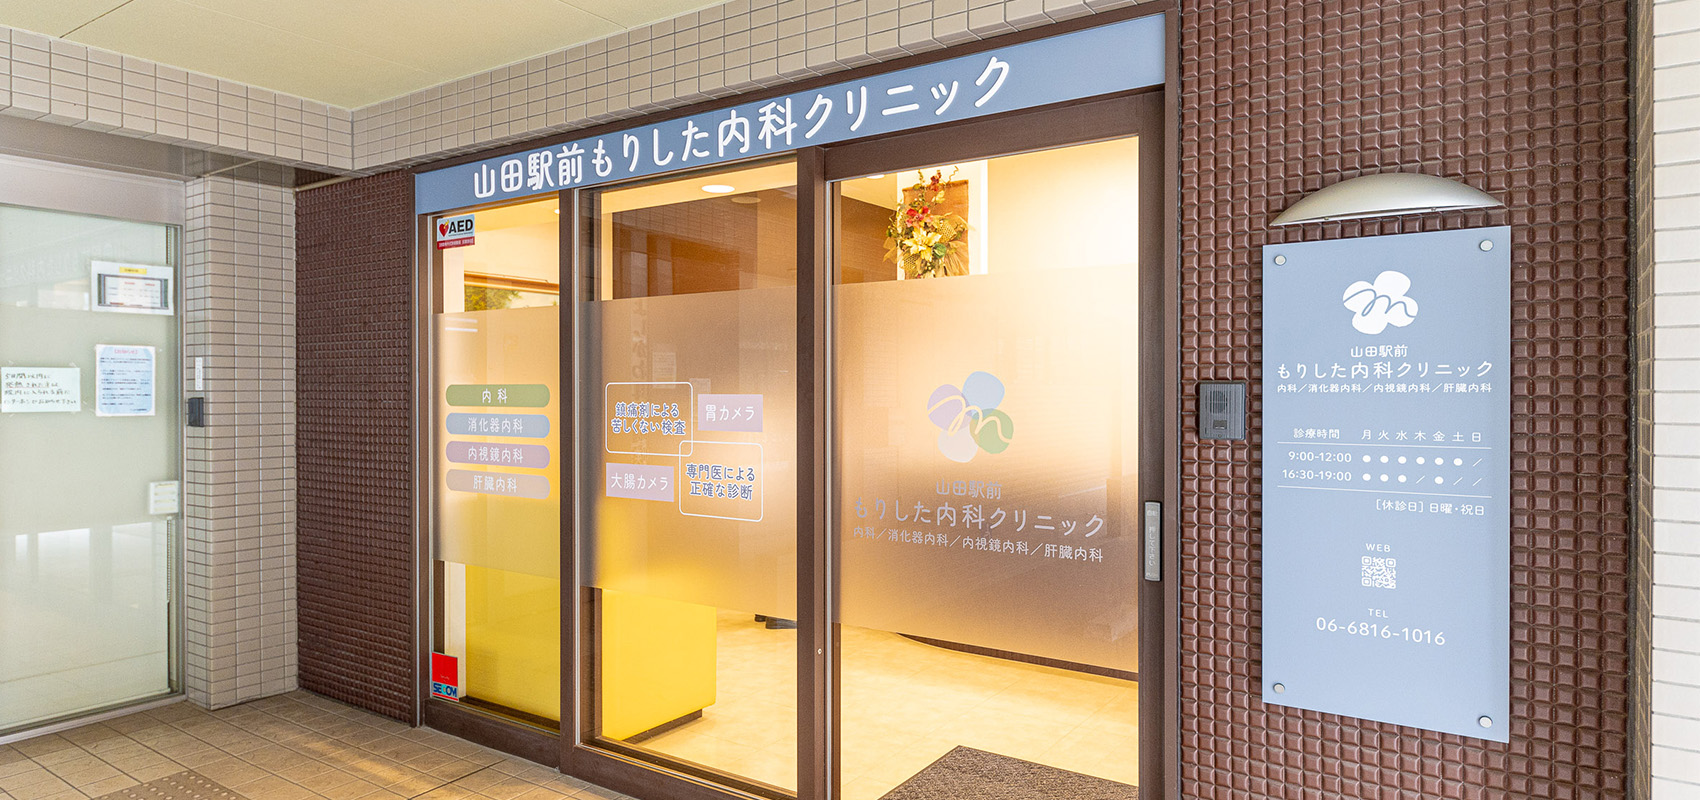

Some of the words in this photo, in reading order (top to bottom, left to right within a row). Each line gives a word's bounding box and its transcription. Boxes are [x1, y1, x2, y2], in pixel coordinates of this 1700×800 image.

[474, 56, 1010, 198] 山田駅前もりした内科クリニック
[449, 219, 473, 234] AED
[1350, 344, 1408, 358] 山田駅前
[1277, 360, 1493, 379] もりした内科クリニック
[615, 402, 680, 418] 鎮痛剤による
[705, 404, 755, 421] 胃カメラ
[468, 417, 523, 434] 消化器内科
[611, 419, 686, 435] 苦しくない検査
[1294, 428, 1340, 439] 診療時間
[468, 446, 523, 463] 内視鏡内科
[1288, 451, 1352, 463] 9:00-12:00
[686, 463, 756, 482] 専門医による
[1282, 469, 1352, 481] 16:30-19:00
[473, 475, 517, 493] 肝臓内科
[611, 473, 669, 491] 大腸カメラ
[936, 479, 1002, 500] 山田駅前
[689, 481, 753, 501] 正確な診断
[854, 497, 1105, 539] もりした内科クリニック
[1366, 543, 1391, 552] WEB
[1368, 608, 1389, 618] TEL
[1316, 617, 1446, 646] 06-6816-1016
[433, 682, 458, 697] SECOM
